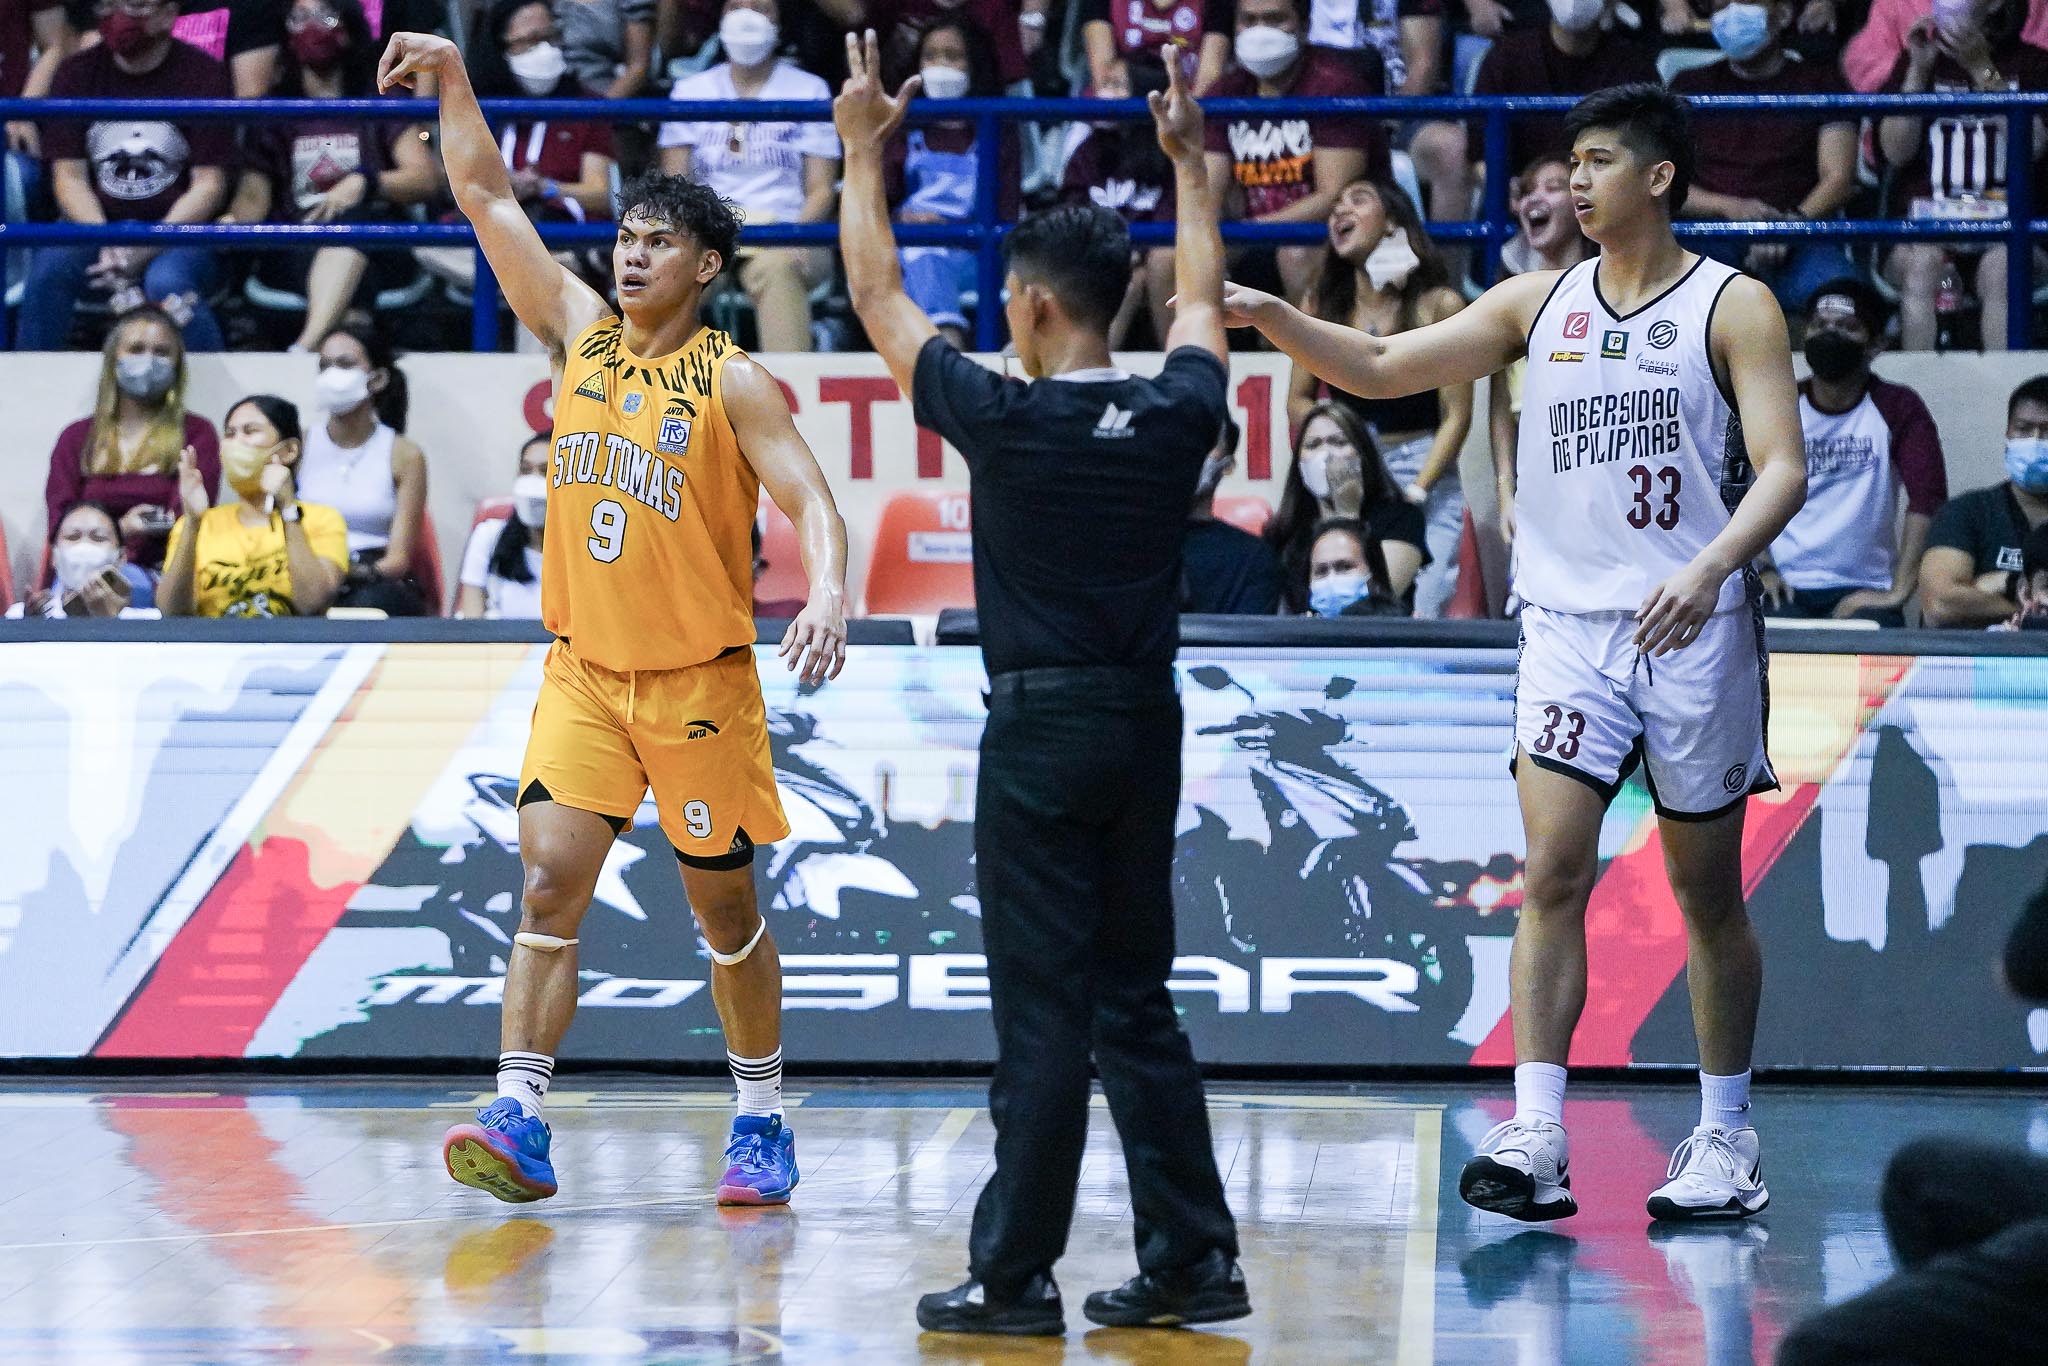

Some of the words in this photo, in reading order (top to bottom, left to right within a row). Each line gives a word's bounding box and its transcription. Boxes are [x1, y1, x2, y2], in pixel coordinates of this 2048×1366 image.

[1639, 358, 1680, 369] CONVERGE
[664, 406, 684, 417] ANTA
[1549, 387, 1680, 438] UNIBERSIDAD
[1552, 437, 1572, 474] NG
[1577, 420, 1680, 468] PILIPINAS
[554, 432, 600, 488] STO.
[601, 433, 685, 523] TOMAS
[1626, 465, 1682, 531] 33
[587, 499, 628, 564] 9
[687, 729, 707, 740] ANTA
[1534, 705, 1586, 761] 33
[683, 800, 713, 839] 9
[366, 976, 707, 1007] mo
